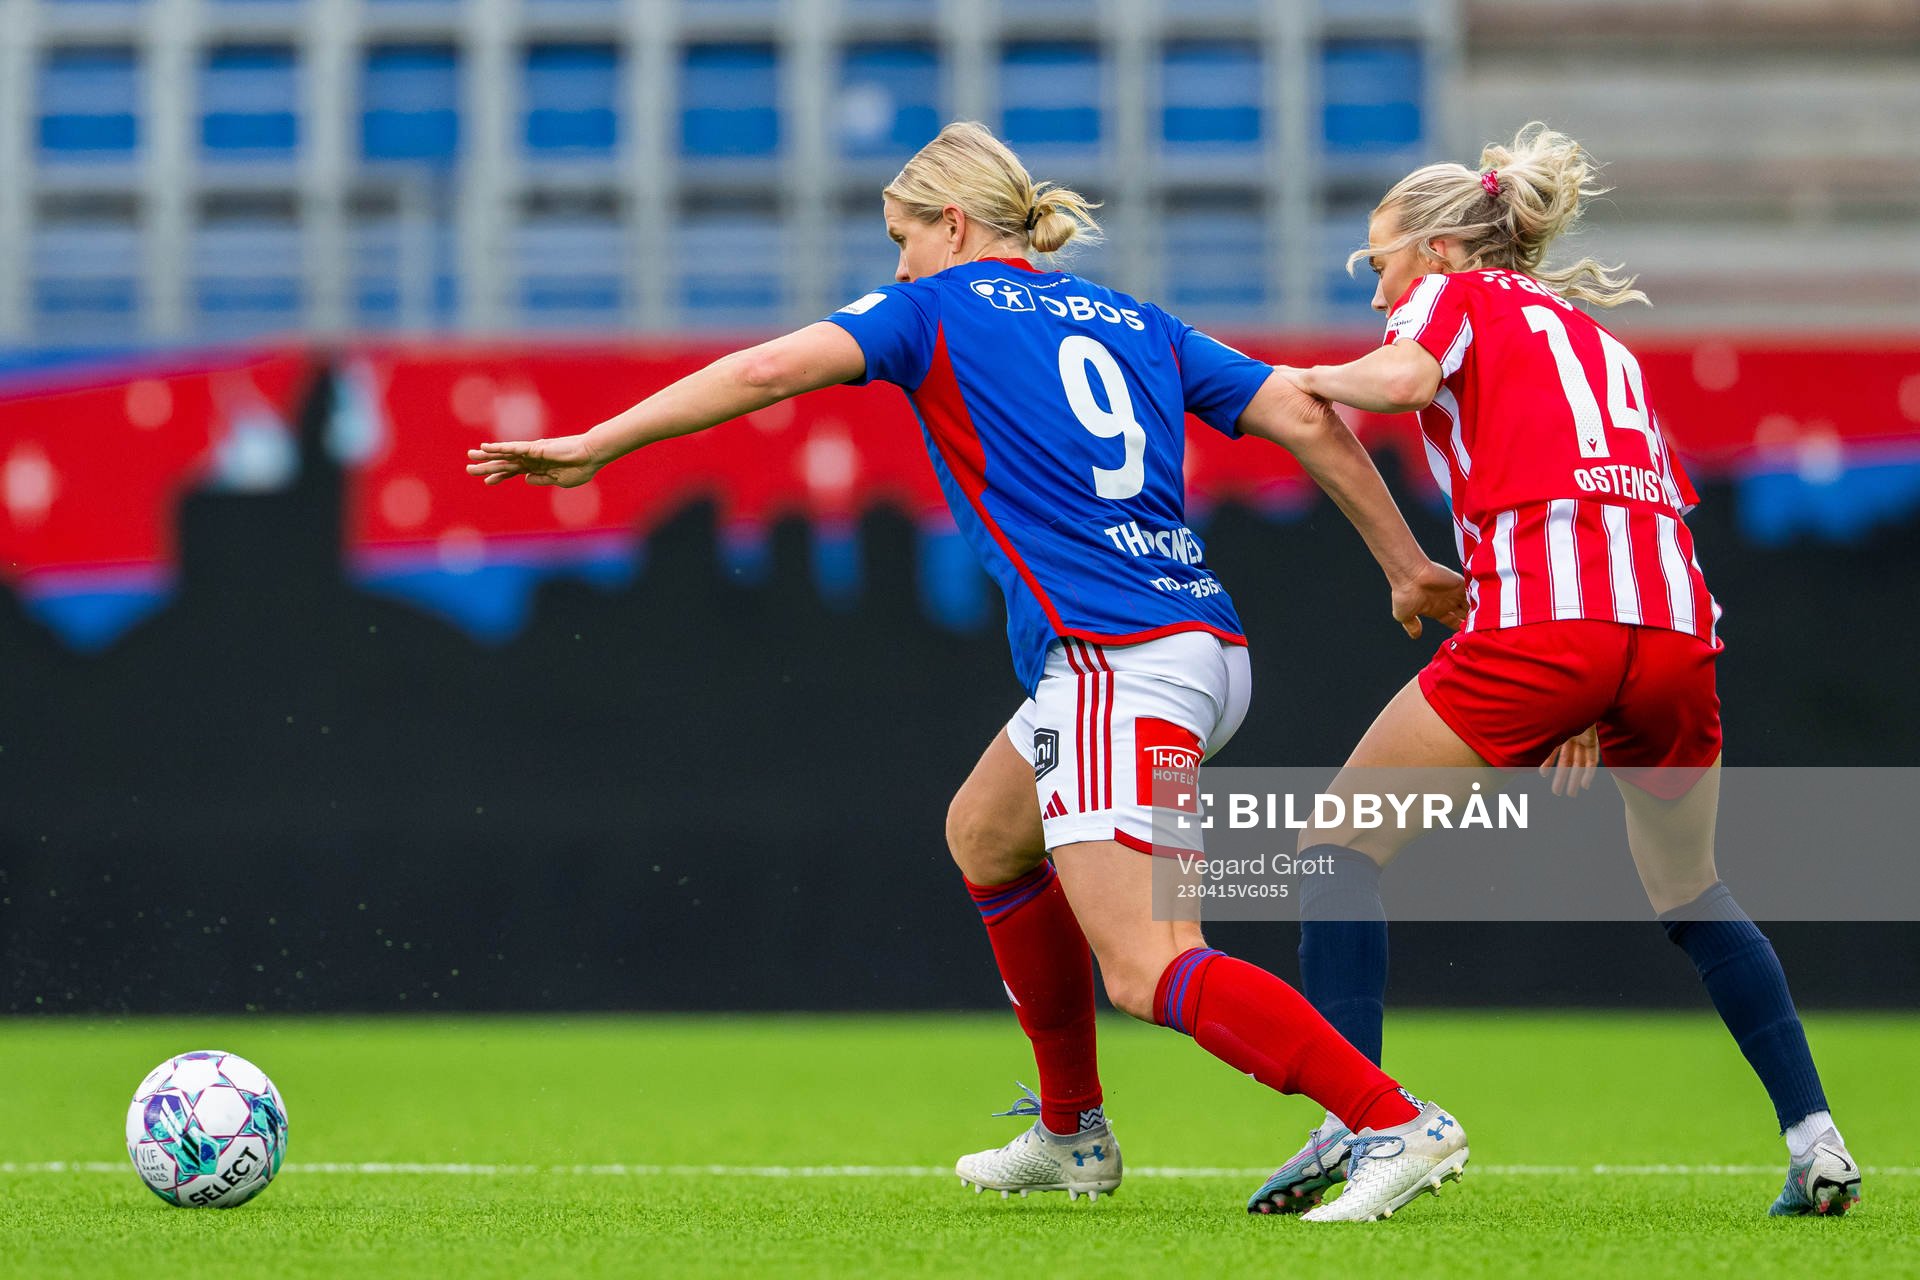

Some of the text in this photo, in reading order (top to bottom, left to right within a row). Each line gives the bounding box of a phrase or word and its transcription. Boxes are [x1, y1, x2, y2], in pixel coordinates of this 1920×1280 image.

[1039, 295, 1145, 331] OBOS
[1521, 304, 1660, 470] 14
[1058, 335, 1147, 500] 9
[1144, 745, 1200, 771] THON
[1153, 769, 1195, 786] HOTELS
[189, 1146, 259, 1207] SELECT
